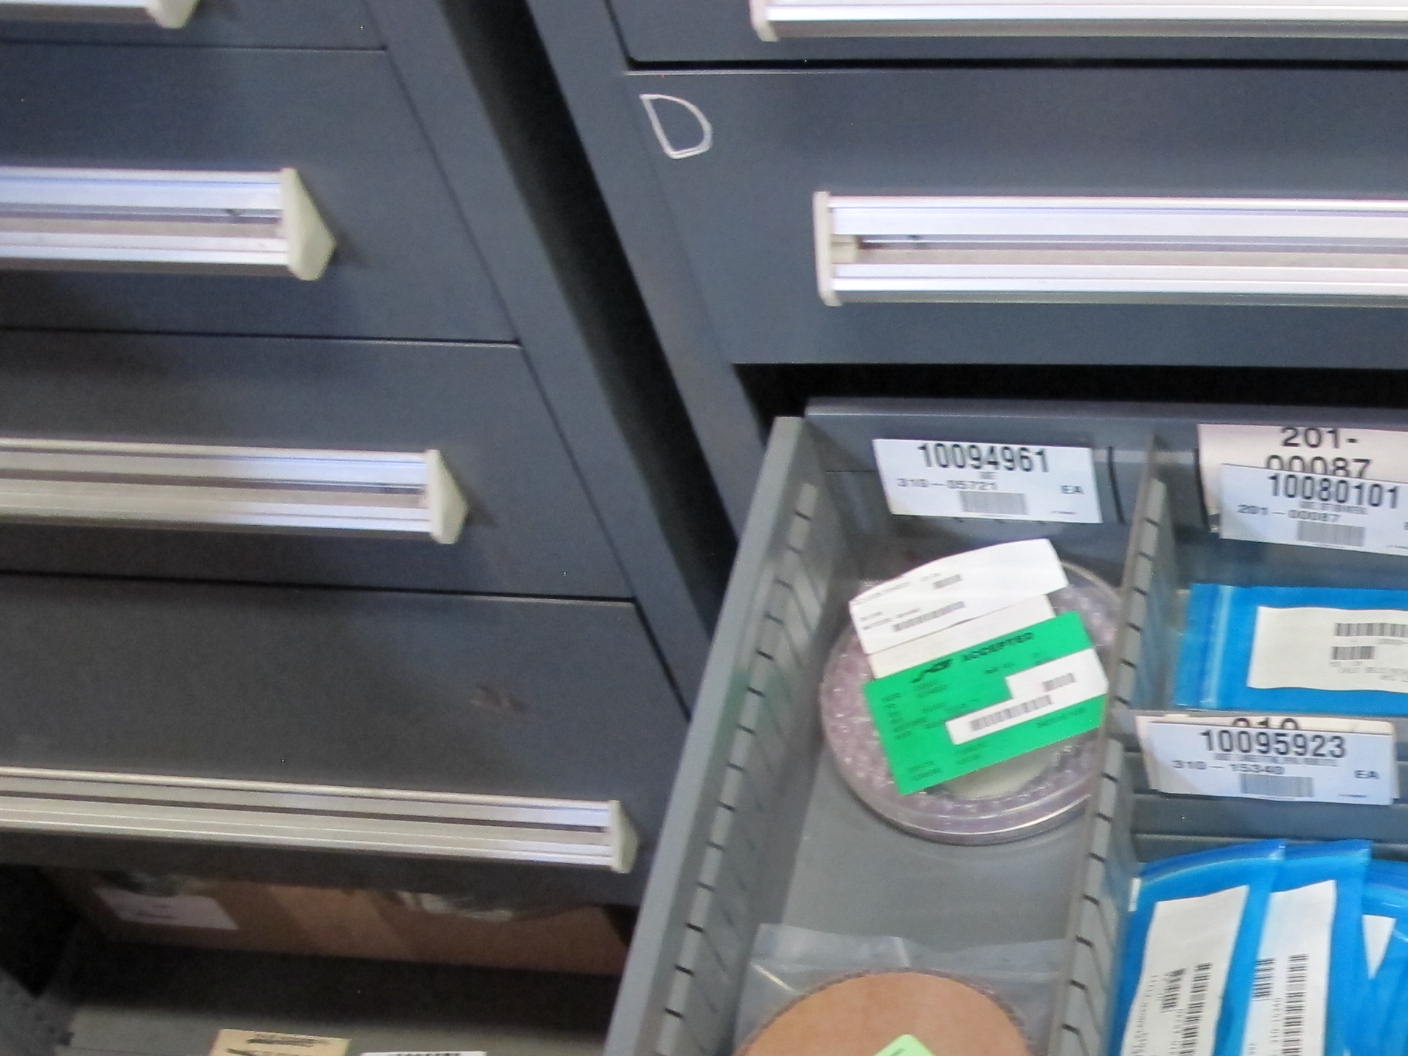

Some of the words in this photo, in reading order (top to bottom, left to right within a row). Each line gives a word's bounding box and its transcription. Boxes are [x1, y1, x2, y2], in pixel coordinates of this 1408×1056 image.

[639, 93, 712, 160] D
[1280, 426, 1359, 449] 201-
[917, 443, 1050, 473] 10094961
[1268, 473, 1399, 509] 10080101
[1200, 729, 1347, 759] 10095923
